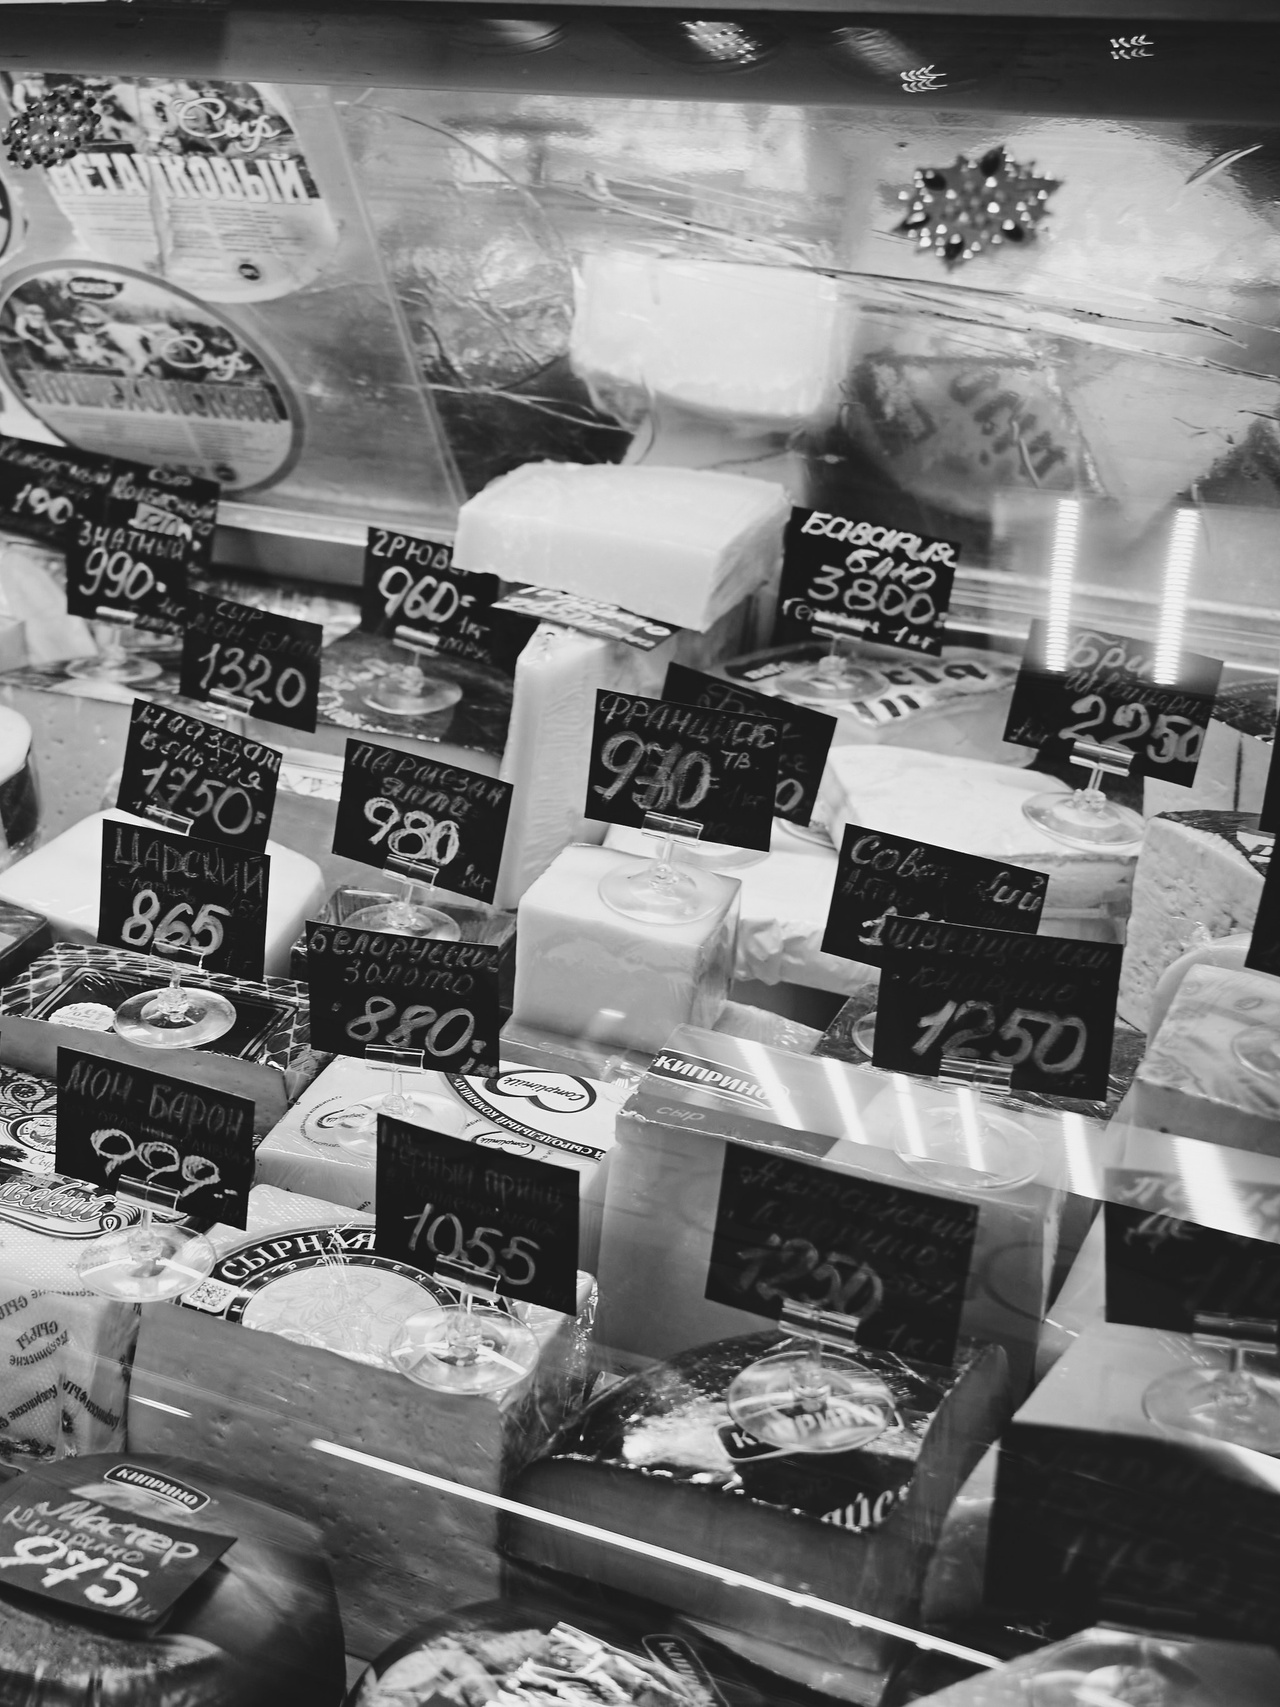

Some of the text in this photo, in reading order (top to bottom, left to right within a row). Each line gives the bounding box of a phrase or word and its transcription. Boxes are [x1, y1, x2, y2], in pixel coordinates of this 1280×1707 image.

[78, 546, 155, 602] 990
[806, 563, 937, 625] 3800
[197, 642, 307, 709] 1320
[1057, 692, 1207, 765] 2250
[112, 827, 266, 900] ЦАРСКИЙ
[363, 796, 461, 867] 980
[121, 888, 233, 957] 865
[911, 999, 1088, 1074] 1250
[221, 1230, 376, 1280] СЫРНАЯ
[403, 1202, 542, 1286] 1055
[15, 1319, 59, 1351] СЫРЫ
[115, 1467, 199, 1506] КИПРИНО
